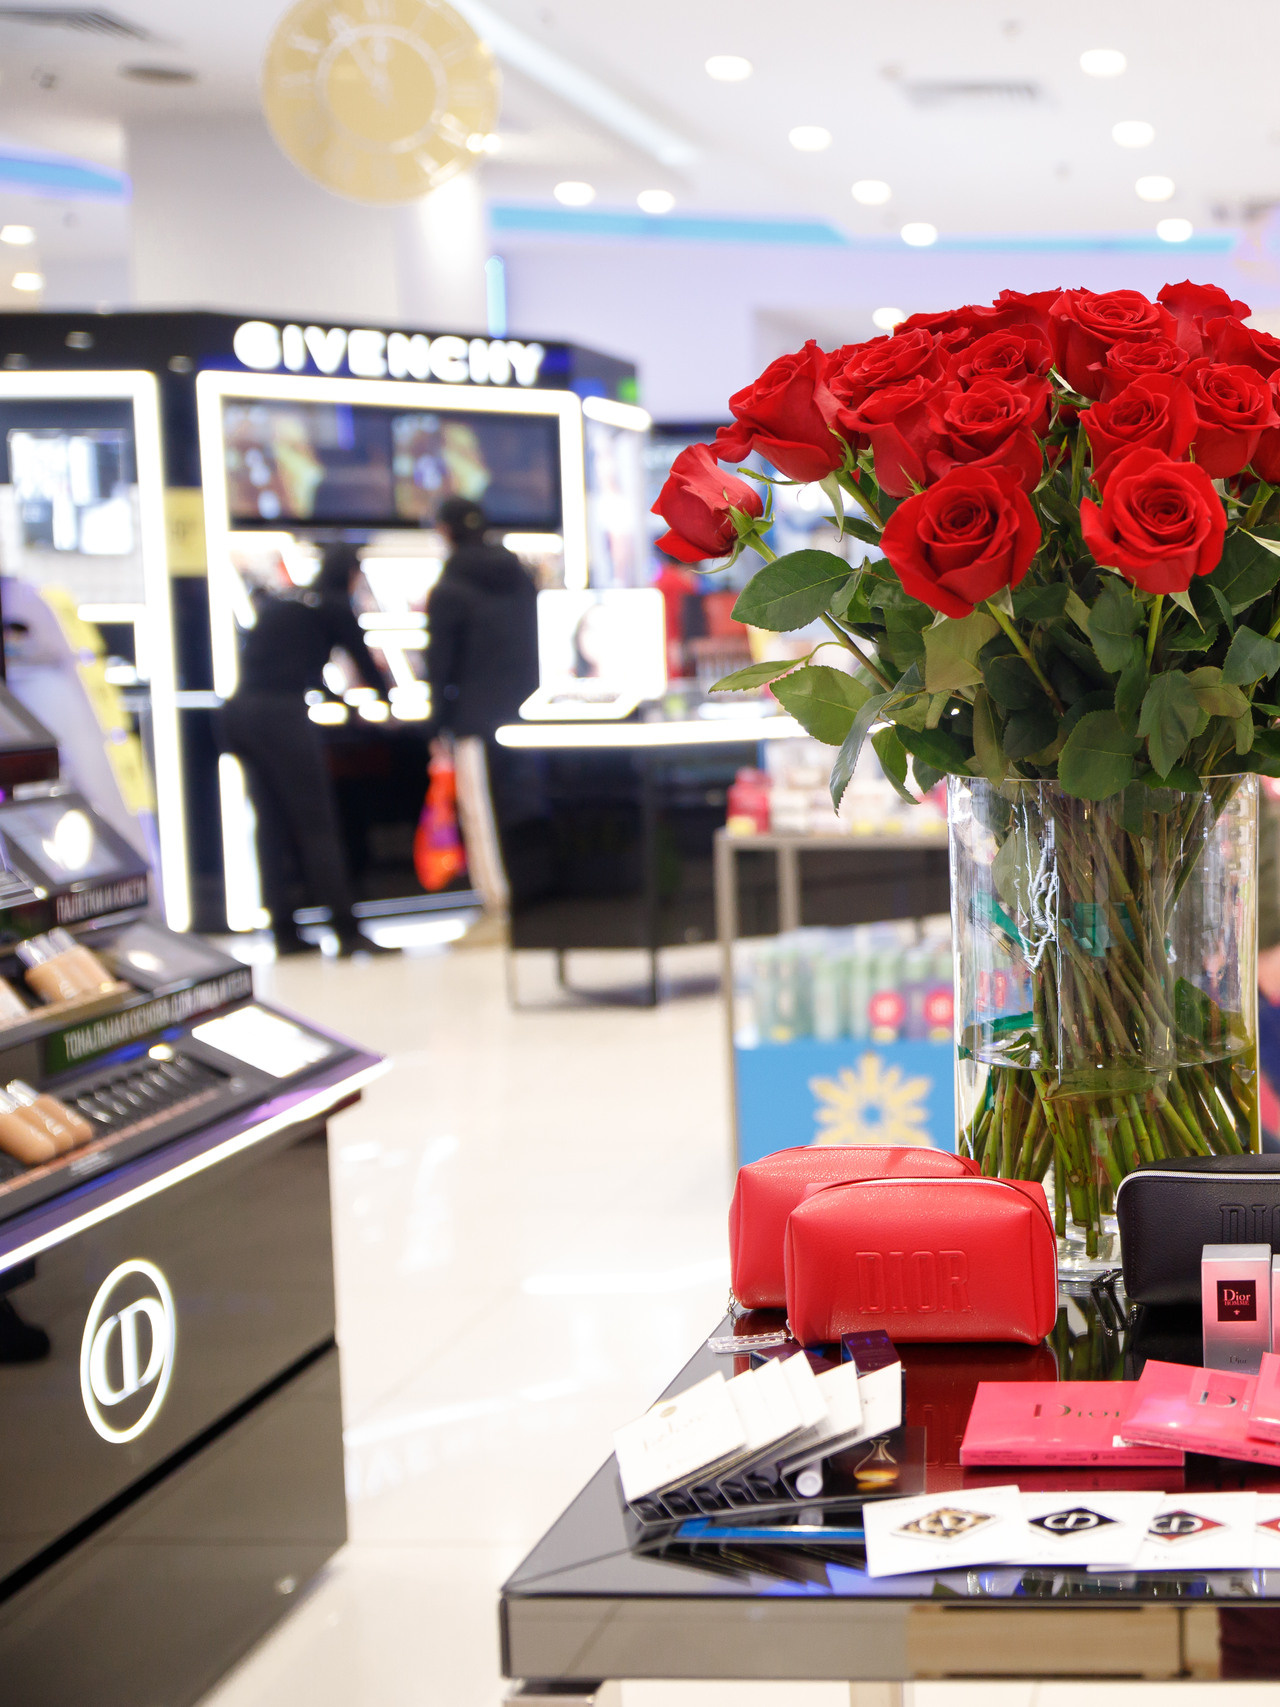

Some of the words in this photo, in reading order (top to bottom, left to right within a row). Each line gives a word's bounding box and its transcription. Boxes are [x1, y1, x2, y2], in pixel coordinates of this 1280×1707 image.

[233, 320, 546, 387] GIVENCHY
[854, 1249, 972, 1316] DIOR
[1223, 1288, 1252, 1302] Dior
